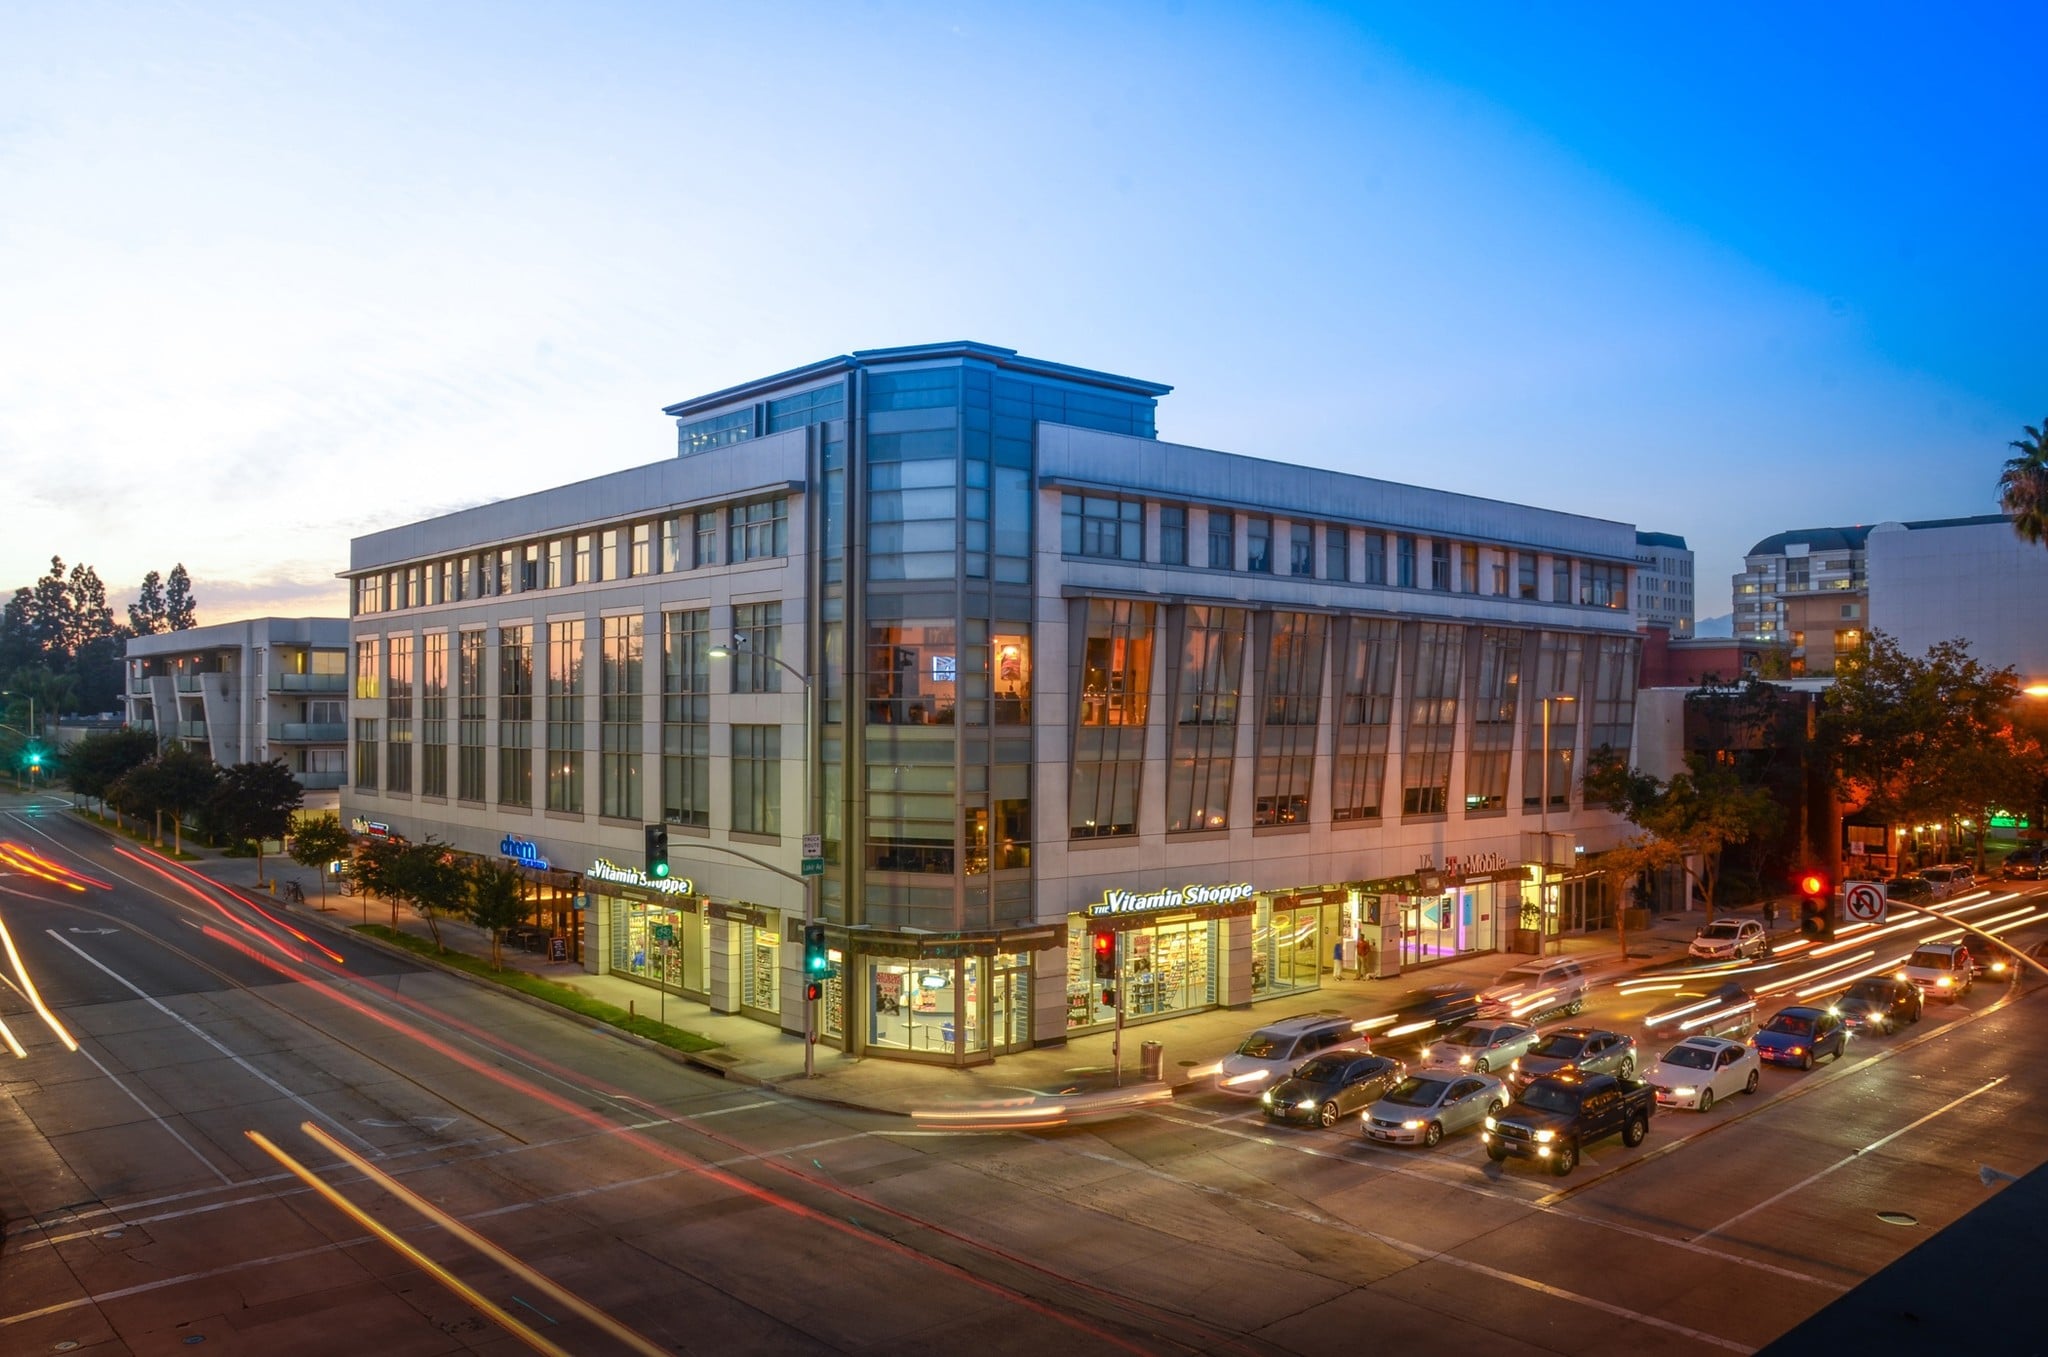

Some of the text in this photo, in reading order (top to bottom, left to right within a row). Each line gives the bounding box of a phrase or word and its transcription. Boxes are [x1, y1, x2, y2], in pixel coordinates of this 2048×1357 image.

[595, 860, 638, 885] Vitamin
[1093, 884, 1253, 915] THE Vitamin Shoppe
